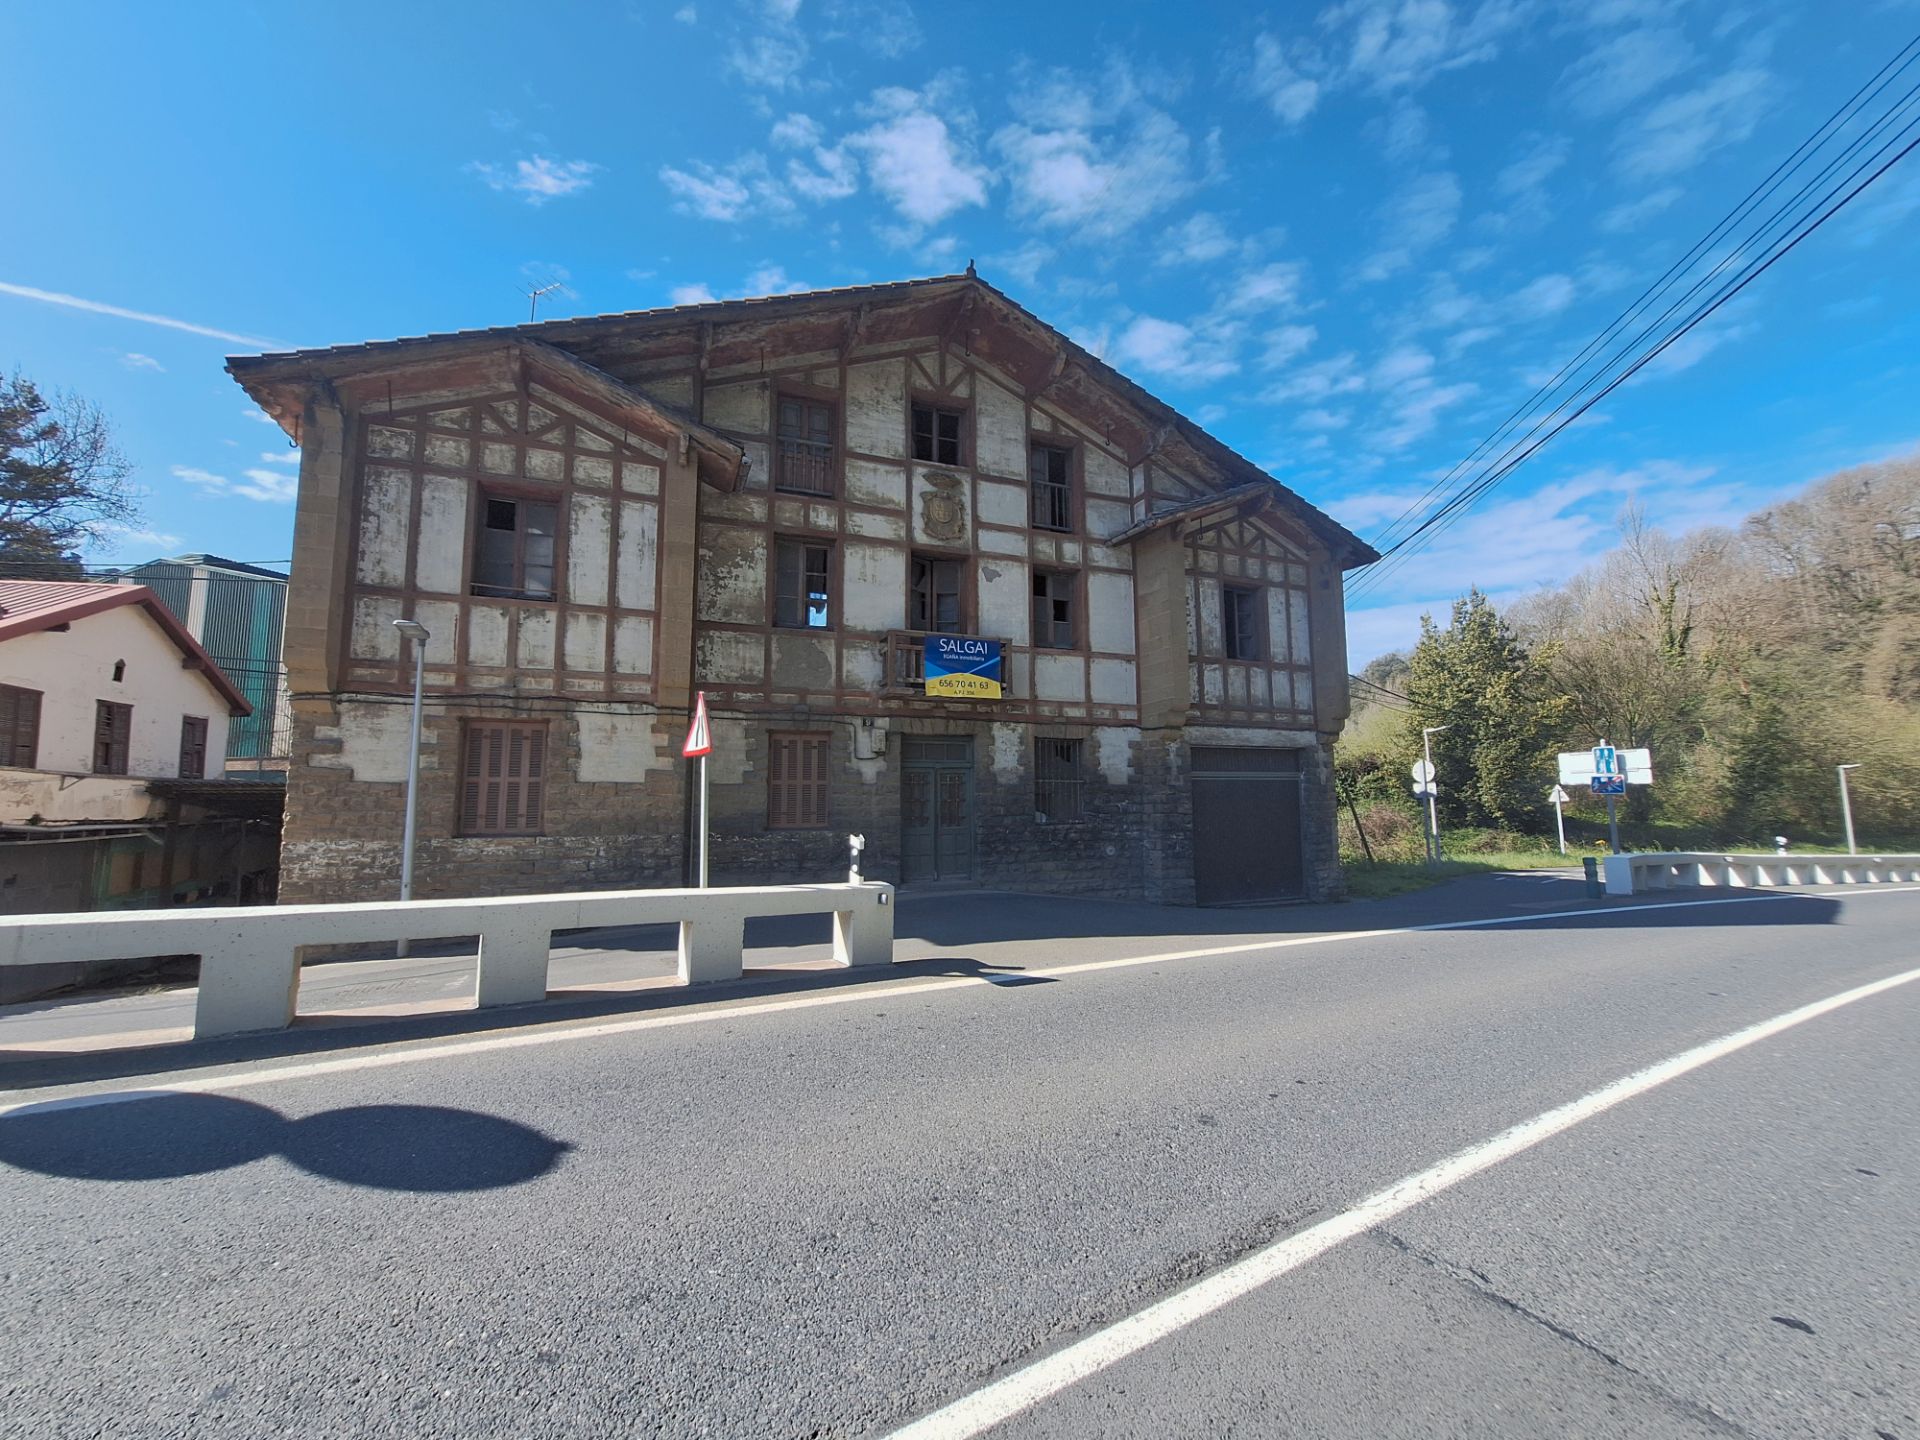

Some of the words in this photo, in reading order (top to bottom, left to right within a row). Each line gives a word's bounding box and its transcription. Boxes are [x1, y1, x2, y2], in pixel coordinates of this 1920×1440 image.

[939, 638, 988, 655] SALGAI
[939, 679, 954, 688] 656
[955, 680, 966, 688] 70
[979, 681, 989, 690] 63
